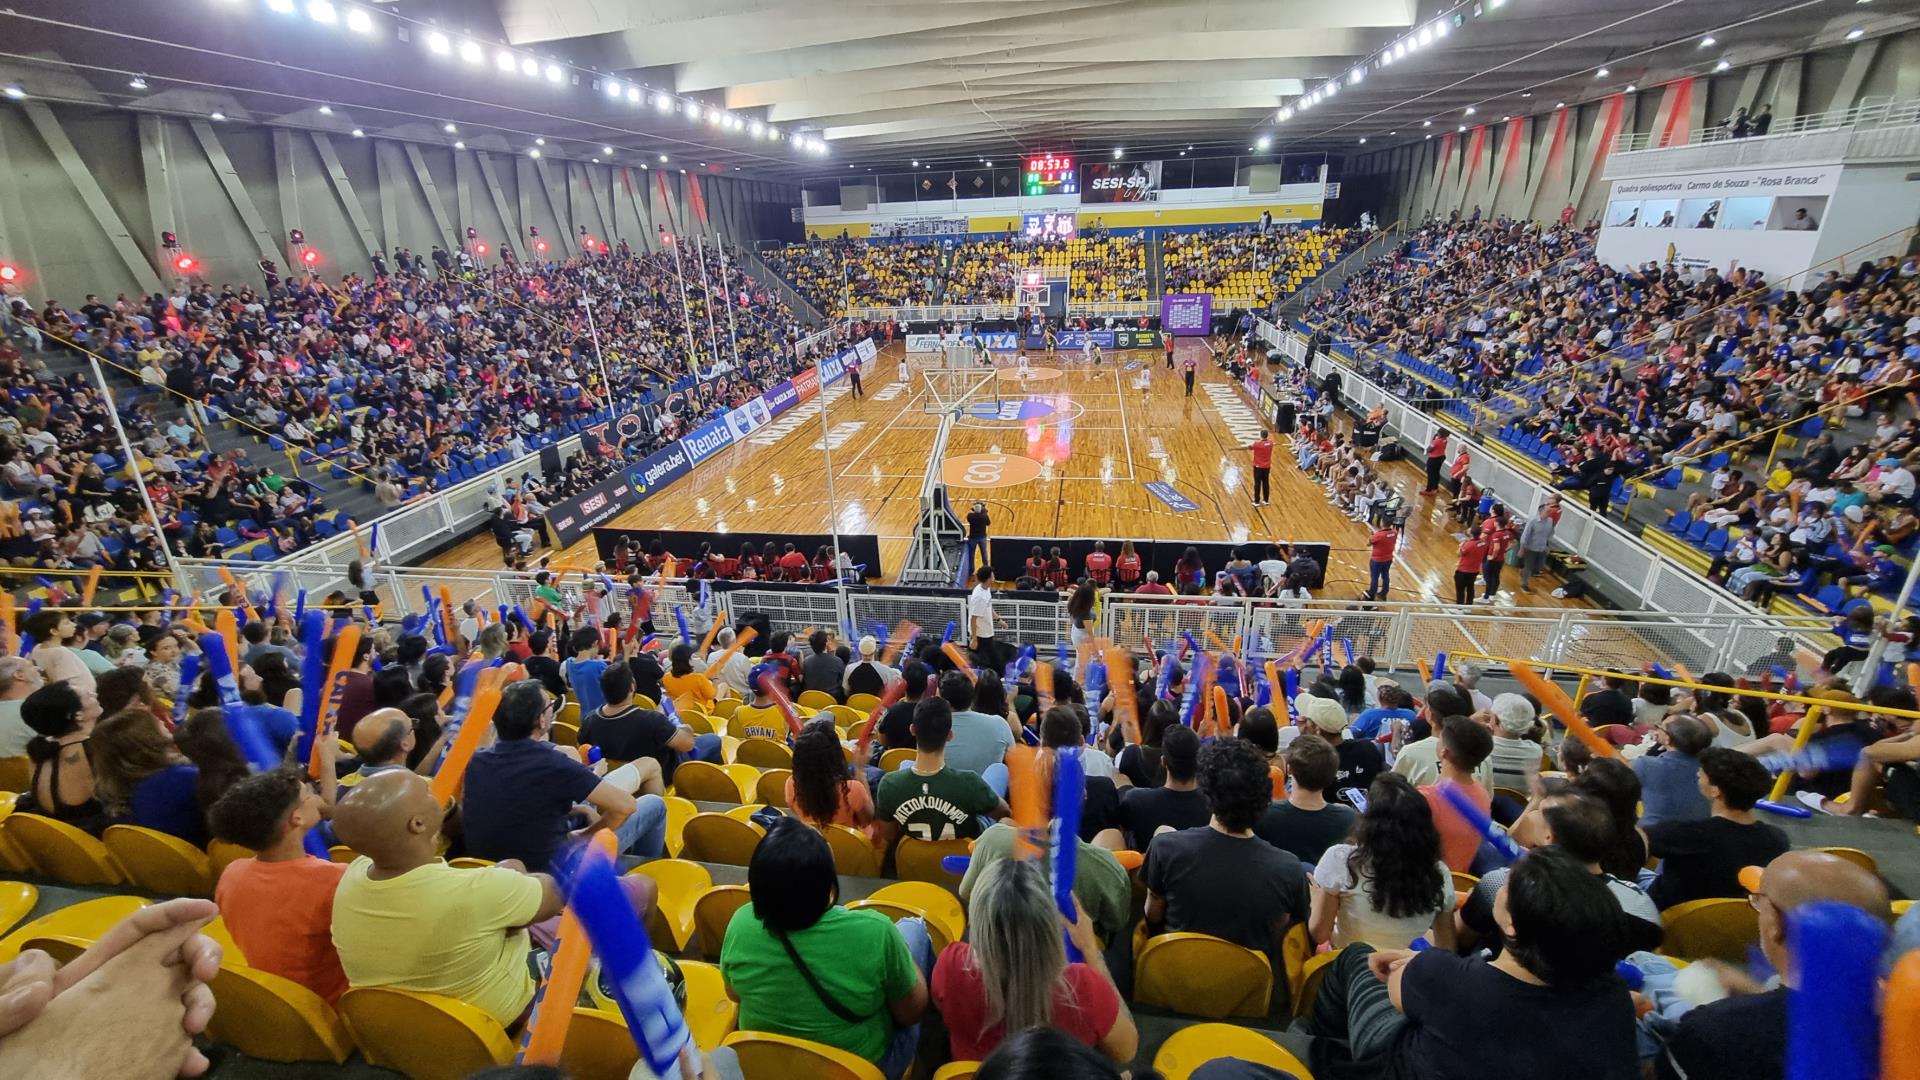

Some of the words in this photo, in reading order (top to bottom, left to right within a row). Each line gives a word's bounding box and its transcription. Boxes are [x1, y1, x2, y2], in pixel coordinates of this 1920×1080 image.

[1617, 185, 1638, 194] Quadra
[1639, 183, 1682, 193] poliesportiva
[1687, 181, 1710, 190] Carmo
[1712, 181, 1723, 189] de
[1725, 179, 1750, 188] Souza
[685, 425, 731, 460] Renata
[644, 449, 686, 486] galera.bet
[613, 484, 629, 497] SESI
[581, 492, 607, 516] SESI
[556, 516, 575, 531] SESI
[744, 726, 776, 738] BRYANT
